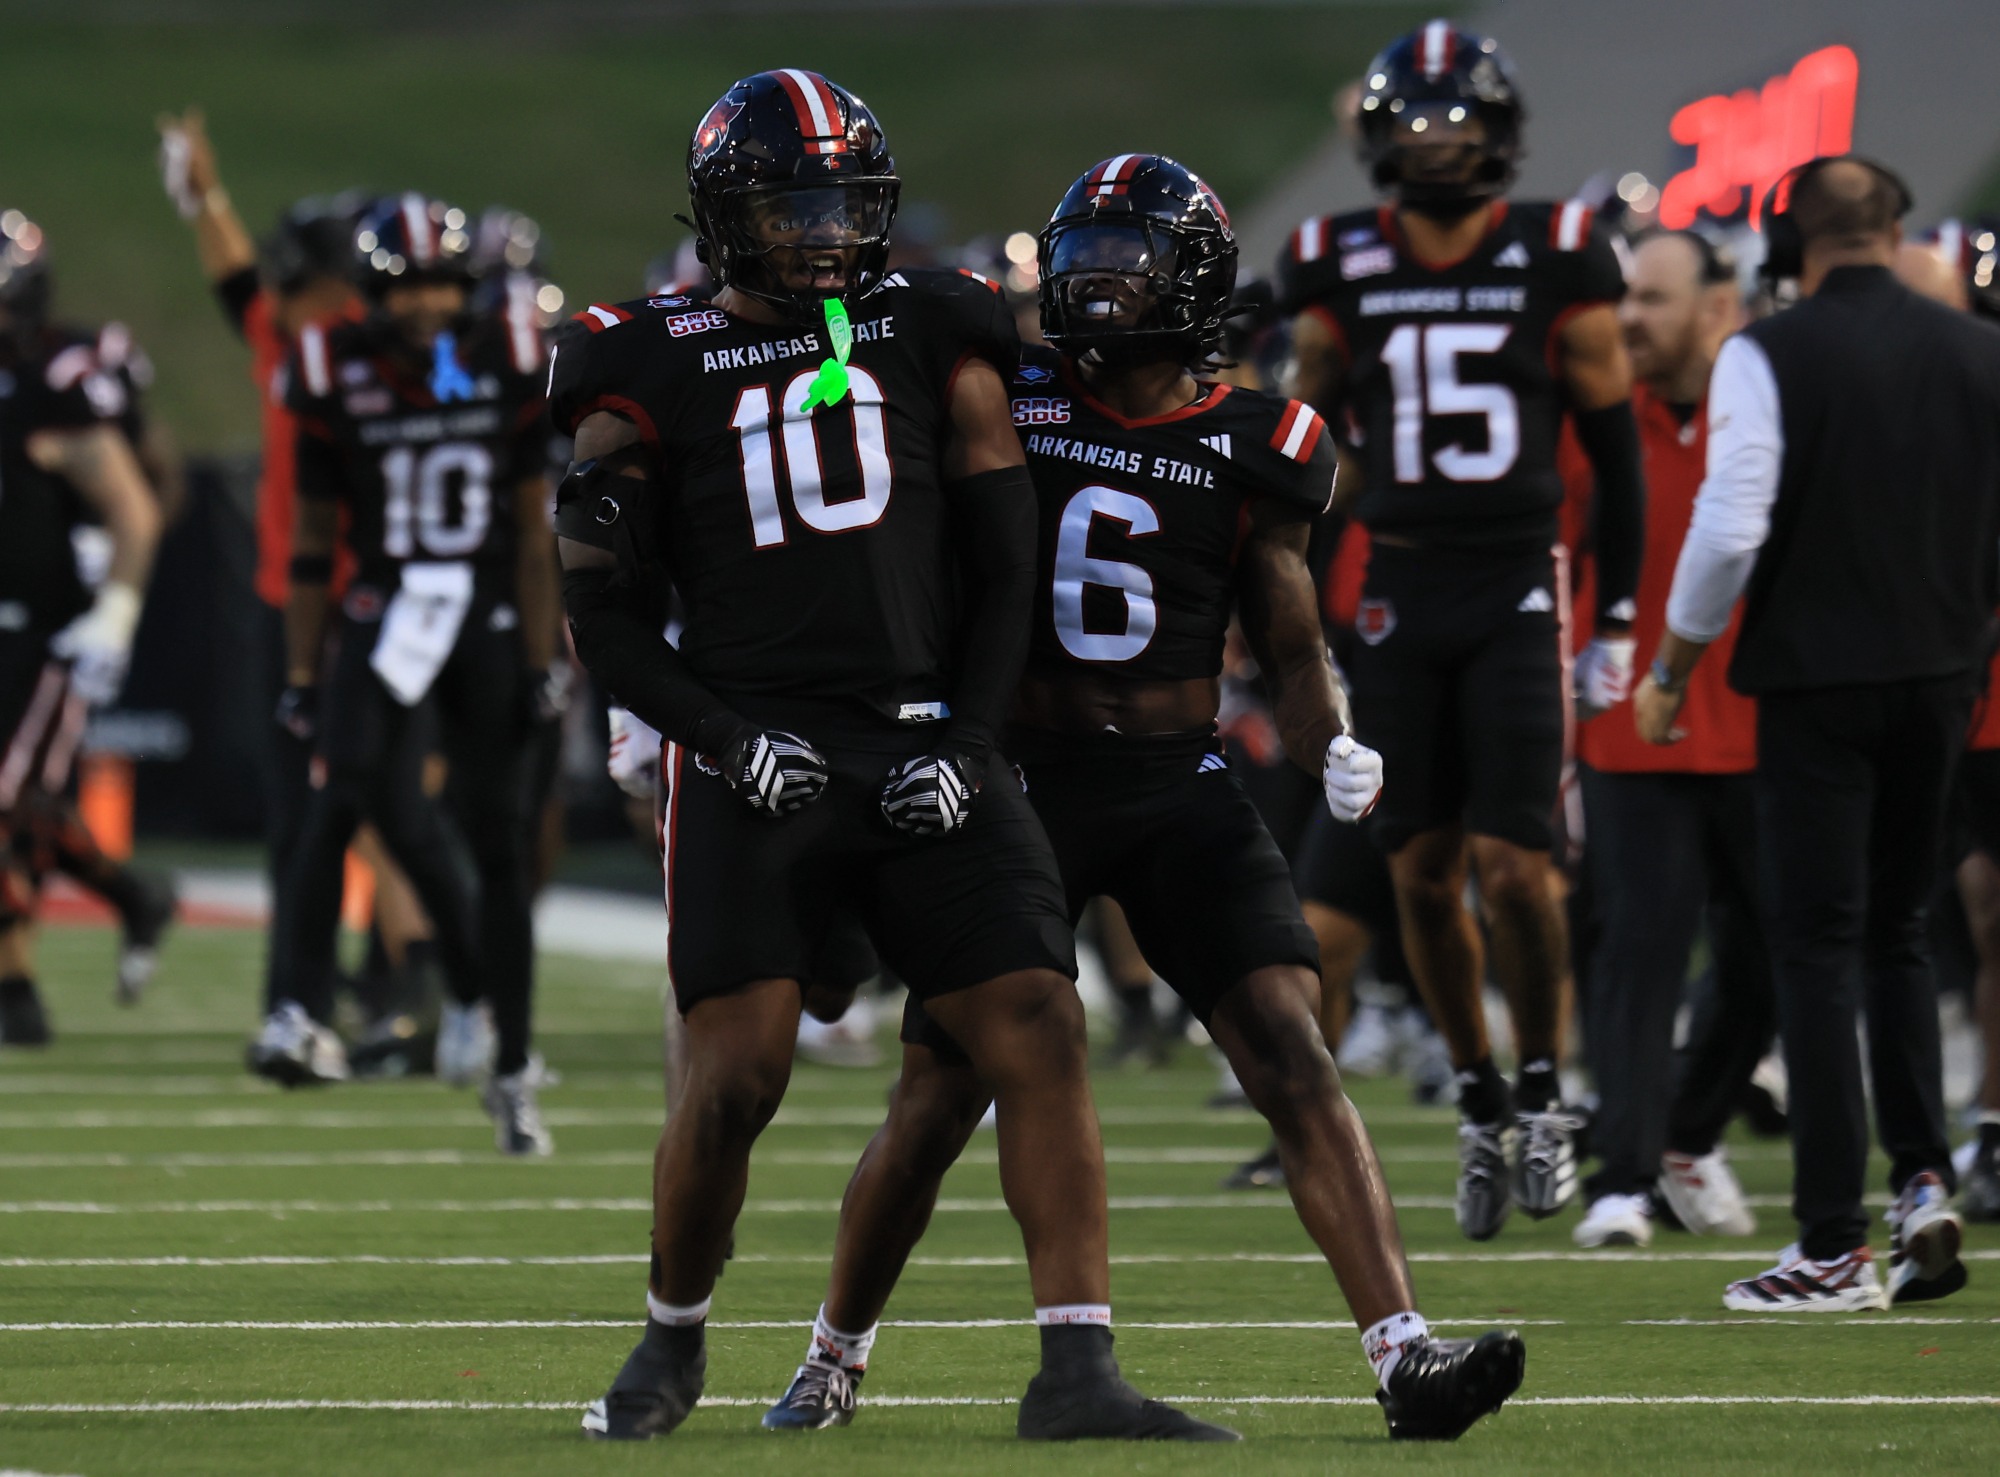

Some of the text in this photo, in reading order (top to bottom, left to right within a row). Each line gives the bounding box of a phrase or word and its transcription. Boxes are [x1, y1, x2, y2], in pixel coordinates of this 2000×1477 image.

[666, 310, 729, 338] SBC
[703, 333, 820, 374] ARKANSAS
[849, 315, 895, 343] TATE
[1012, 397, 1071, 427] SBC
[1379, 321, 1521, 484] 15
[381, 442, 493, 558] 10
[727, 363, 895, 551] 10
[1026, 434, 1215, 490] ARKANSAS STATE
[1052, 483, 1163, 663] 6
